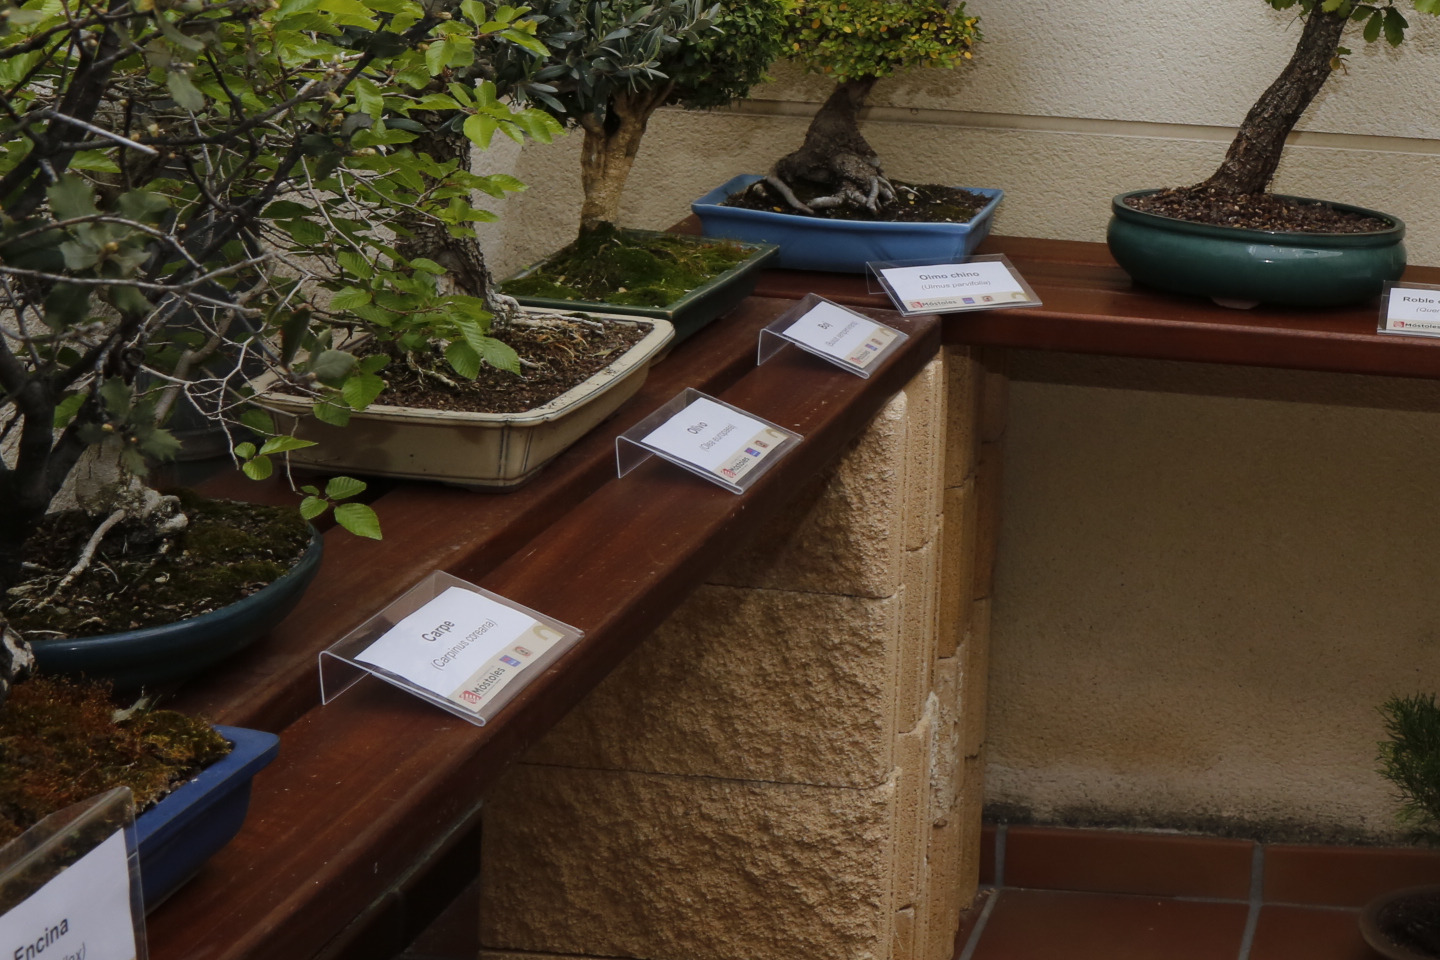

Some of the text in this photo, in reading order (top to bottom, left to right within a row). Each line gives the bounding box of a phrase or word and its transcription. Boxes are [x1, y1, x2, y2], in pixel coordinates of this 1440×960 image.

[1403, 296, 1435, 304] Roble
[421, 620, 455, 642] Carpe
[430, 618, 498, 671] (Carpinus coreana)
[472, 667, 506, 696] Móstoles
[14, 918, 69, 960] Encina
